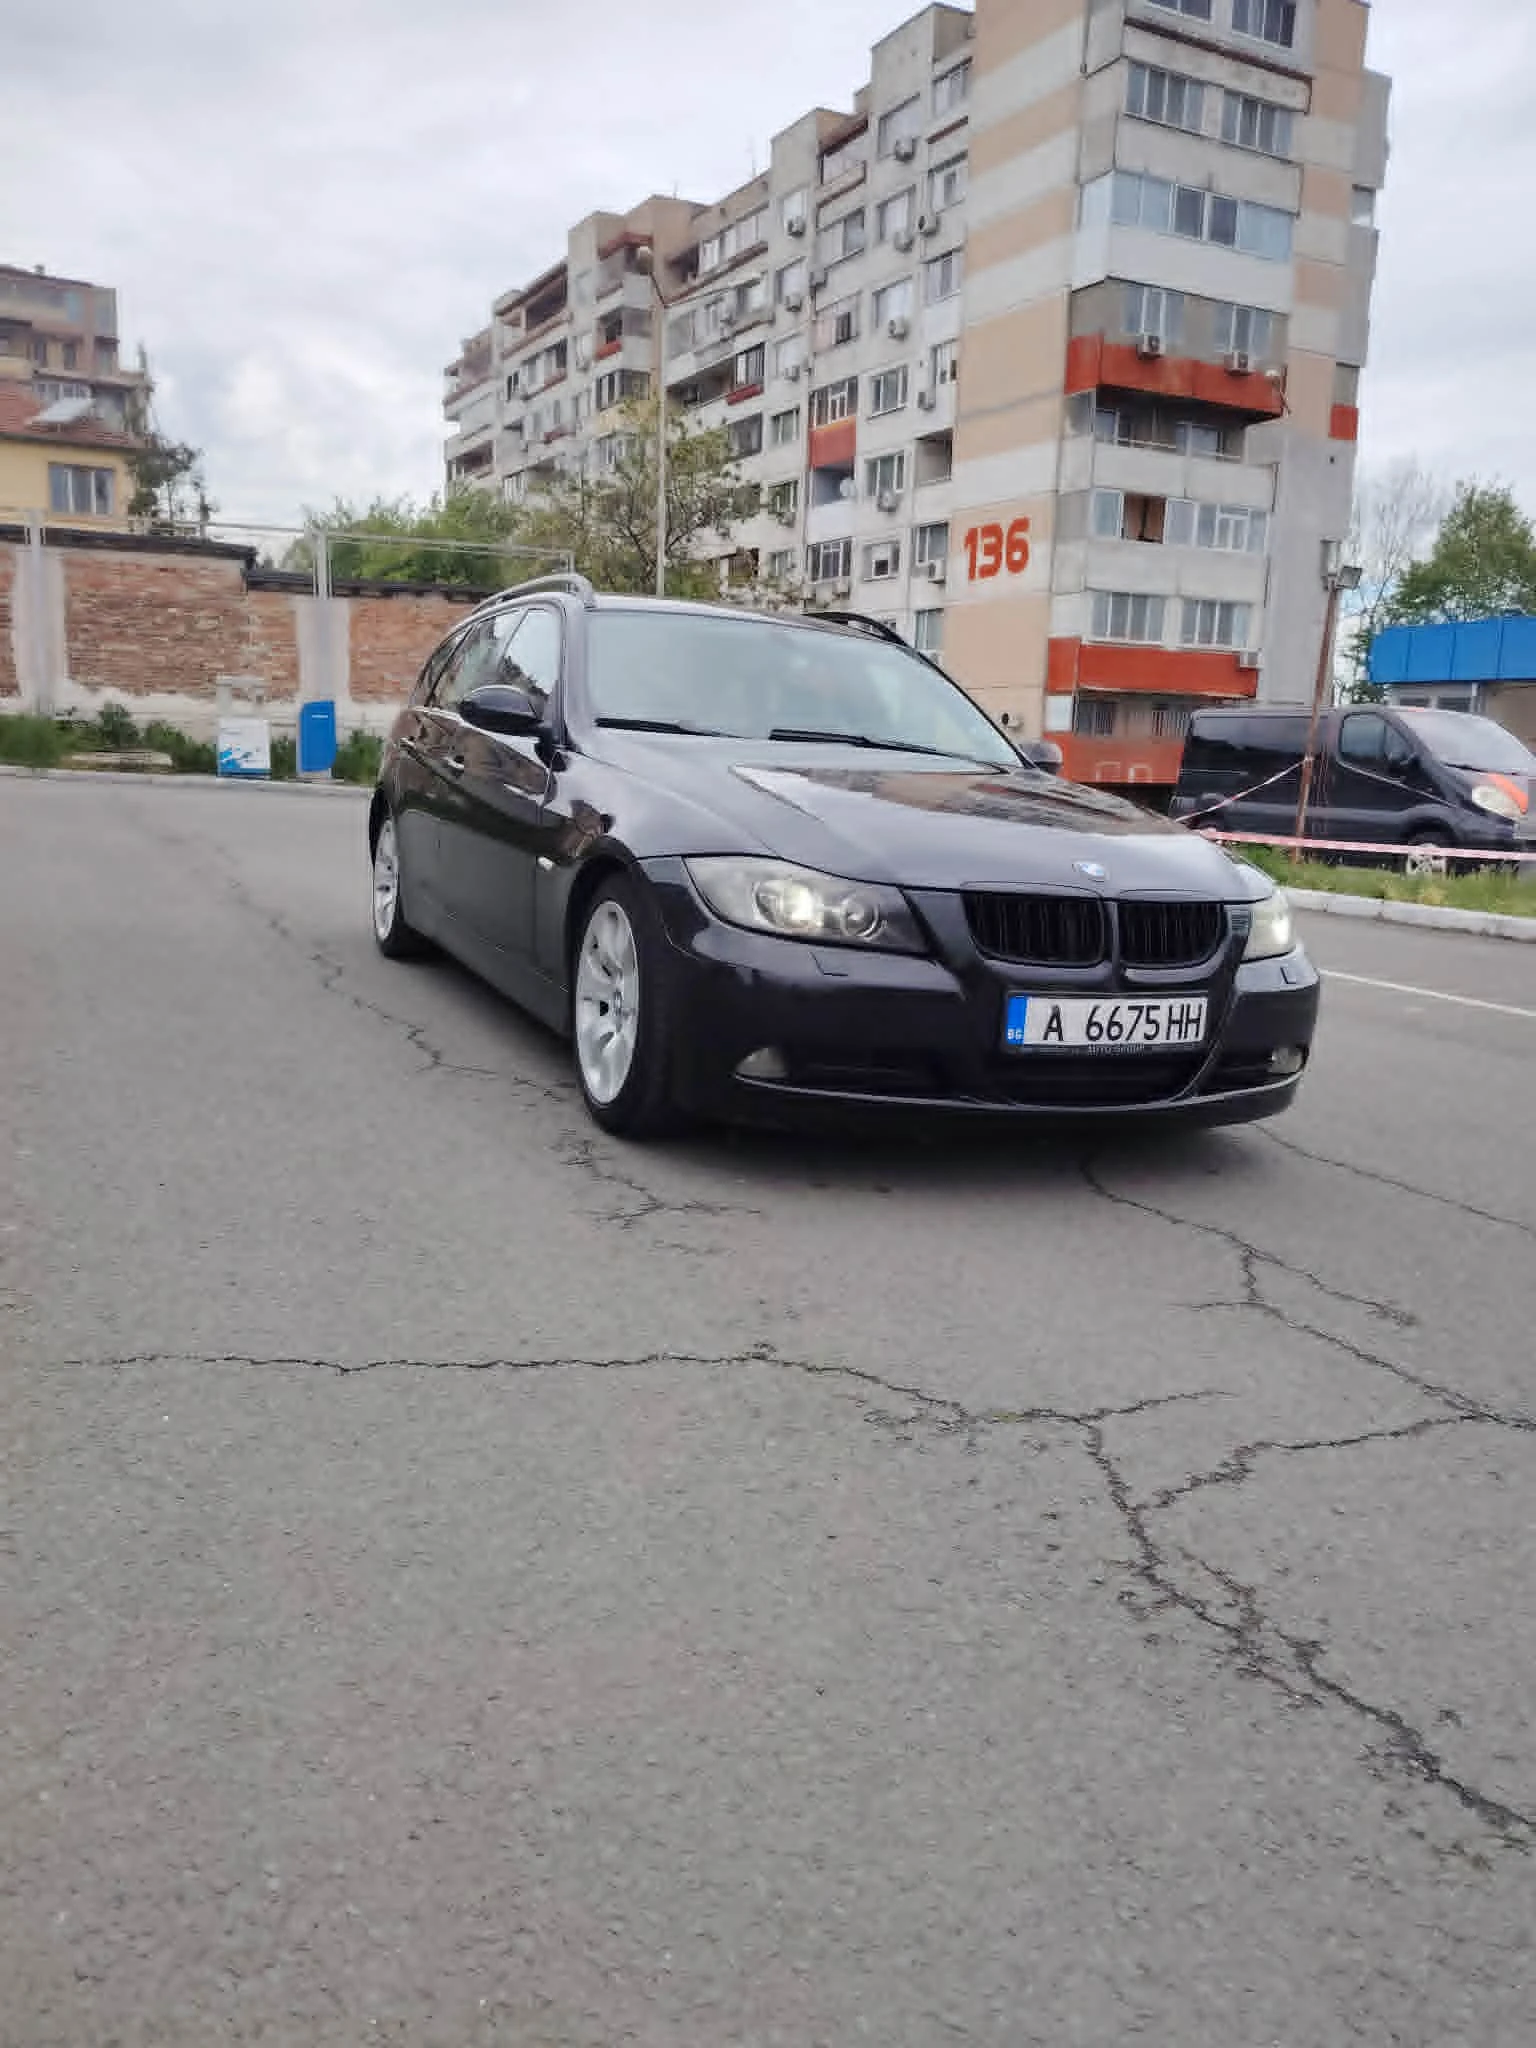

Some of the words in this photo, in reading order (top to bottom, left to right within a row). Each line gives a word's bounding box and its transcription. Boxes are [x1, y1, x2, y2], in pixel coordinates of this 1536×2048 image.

[964, 516, 1031, 581] 136
[1043, 1004, 1064, 1041] A
[1085, 1005, 1160, 1041] 6675
[1166, 1003, 1203, 1041] HH
